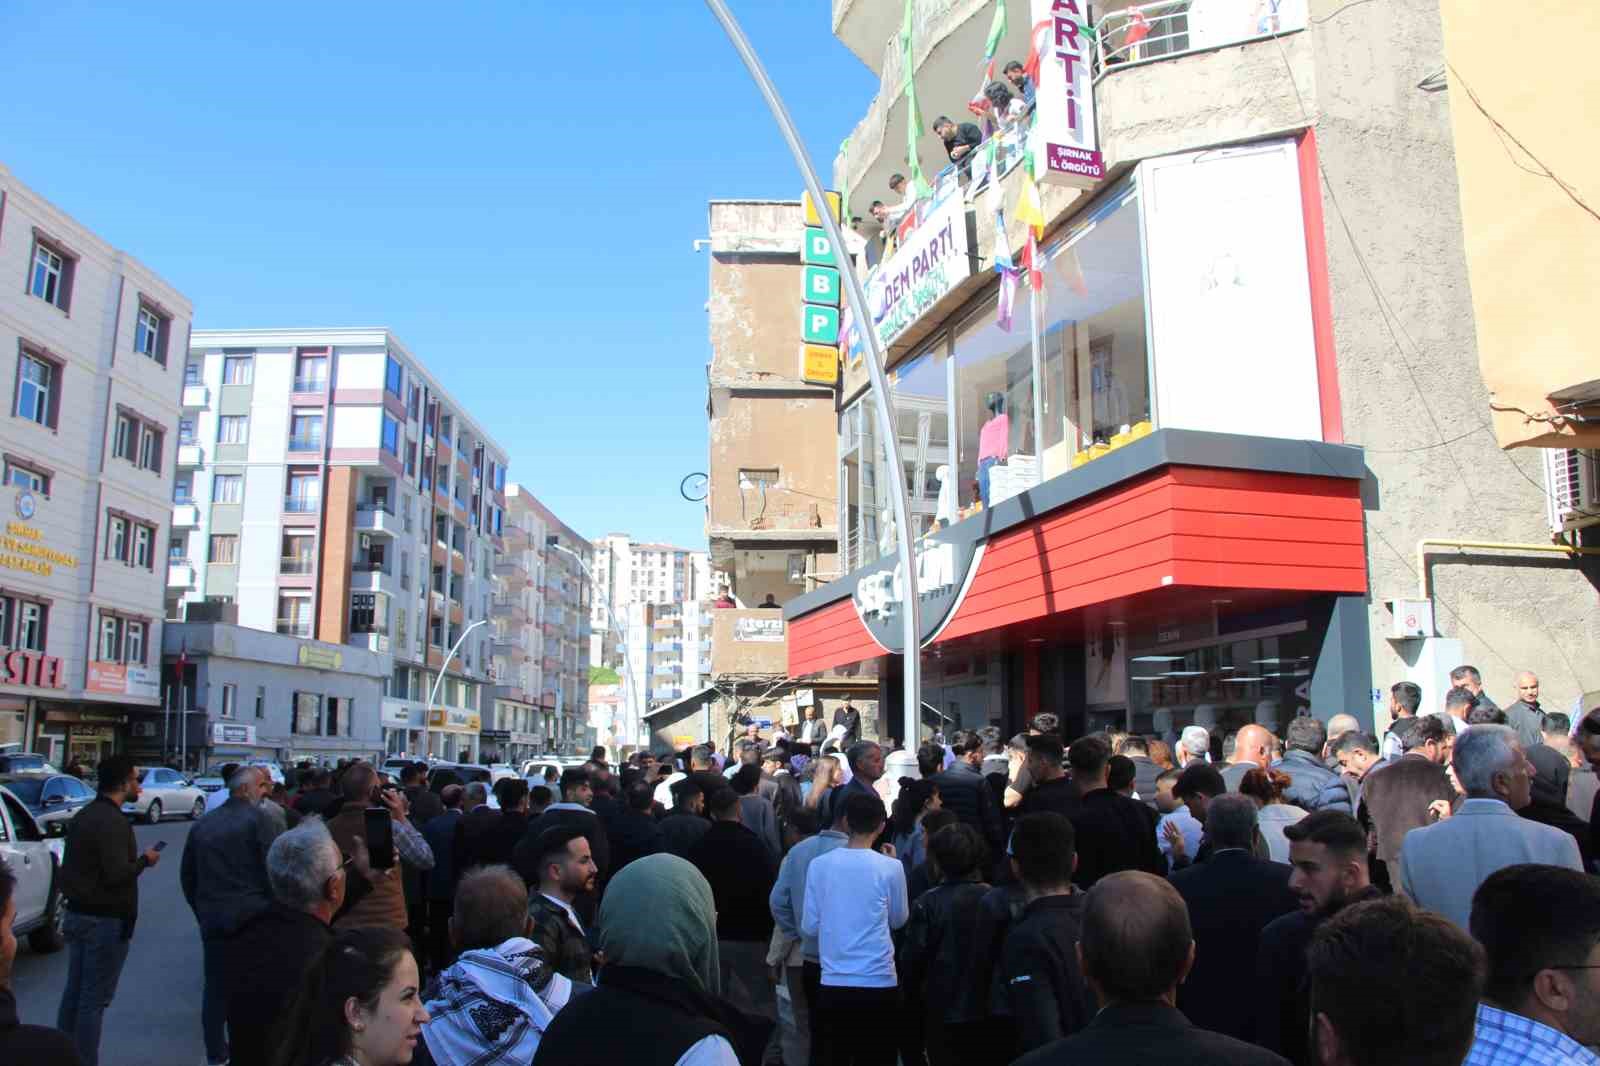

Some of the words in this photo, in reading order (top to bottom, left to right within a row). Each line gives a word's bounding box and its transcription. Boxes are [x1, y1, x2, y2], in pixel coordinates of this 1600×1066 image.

[1057, 148, 1092, 162] ŞIRNAK
[1050, 158, 1060, 170] İL
[1061, 160, 1100, 176] ÖRGÜTÜ
[885, 266, 910, 310] DEM
[912, 216, 953, 276] PARTİ
